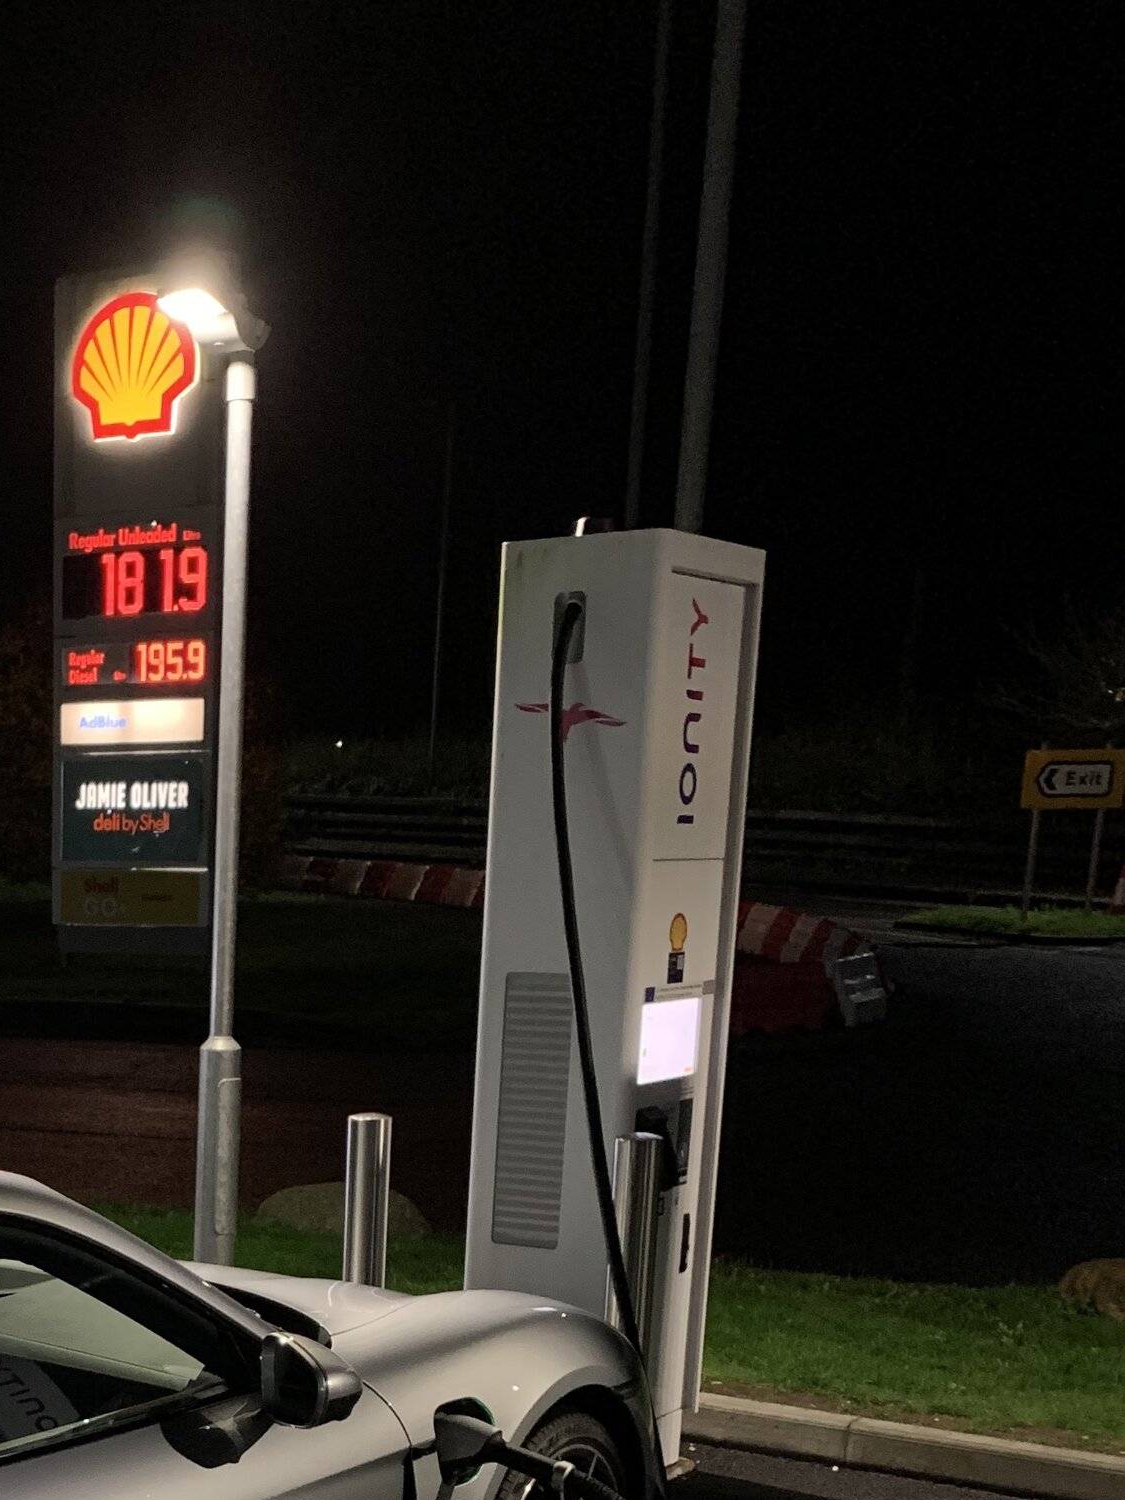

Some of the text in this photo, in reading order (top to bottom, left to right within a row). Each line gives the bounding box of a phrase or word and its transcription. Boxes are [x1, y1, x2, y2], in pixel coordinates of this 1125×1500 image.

[69, 529, 115, 552] Regular
[118, 523, 177, 546] Unleaded
[69, 650, 105, 668] Regular
[136, 640, 206, 682] 195.9
[69, 667, 97, 684] Diesel
[80, 714, 126, 728] AdBlue
[677, 598, 709, 825] IONITY
[1065, 770, 1102, 786] Exit
[75, 781, 189, 809] JAMIE OLIVER
[93, 811, 171, 835] deli by Shell
